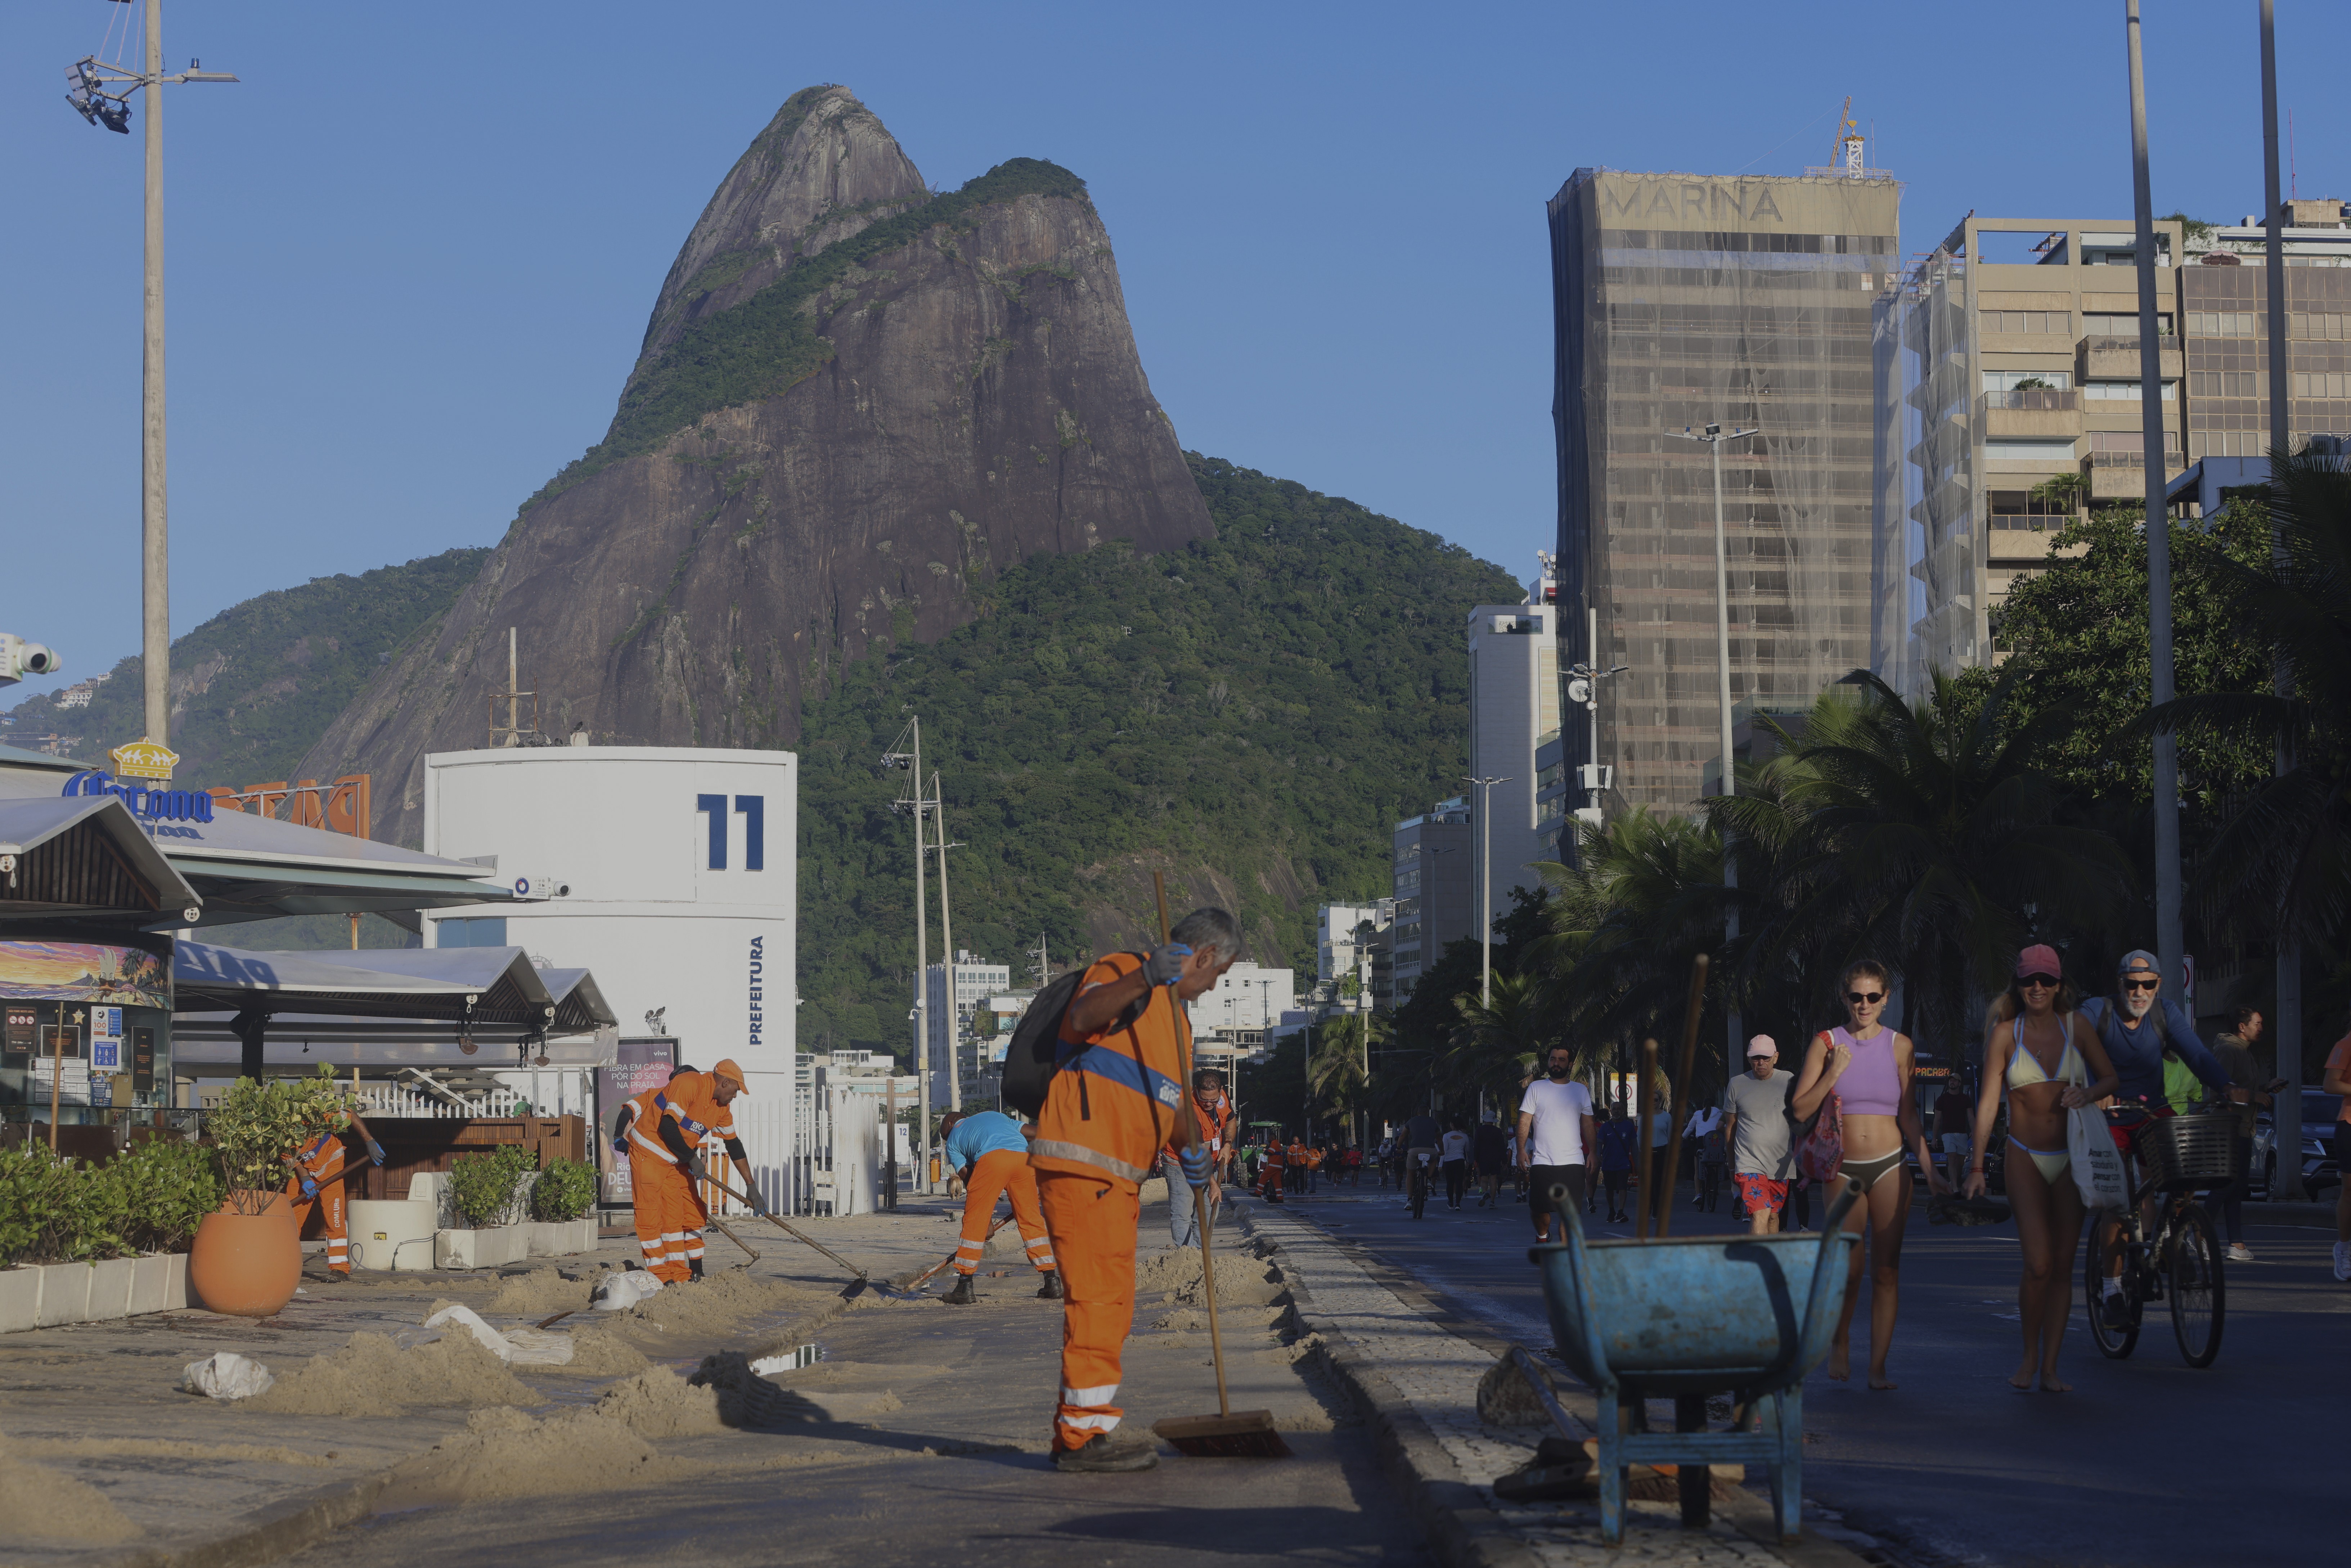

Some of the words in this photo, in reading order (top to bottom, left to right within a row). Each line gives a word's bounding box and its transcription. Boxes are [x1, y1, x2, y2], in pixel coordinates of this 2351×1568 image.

[1605, 184, 1784, 221] MARINA
[61, 770, 215, 823] Corona
[696, 794, 764, 870] 11
[749, 935, 763, 1045] PREFEITURA
[644, 1063, 667, 1071] CASA,
[612, 1072, 628, 1080] PÔR
[690, 1121, 703, 1131] RIO
[2088, 1148, 2102, 1157] Amar
[608, 1172, 631, 1185] DEU
[2093, 1173, 2110, 1181] pensar
[2094, 1182, 2100, 1191] el
